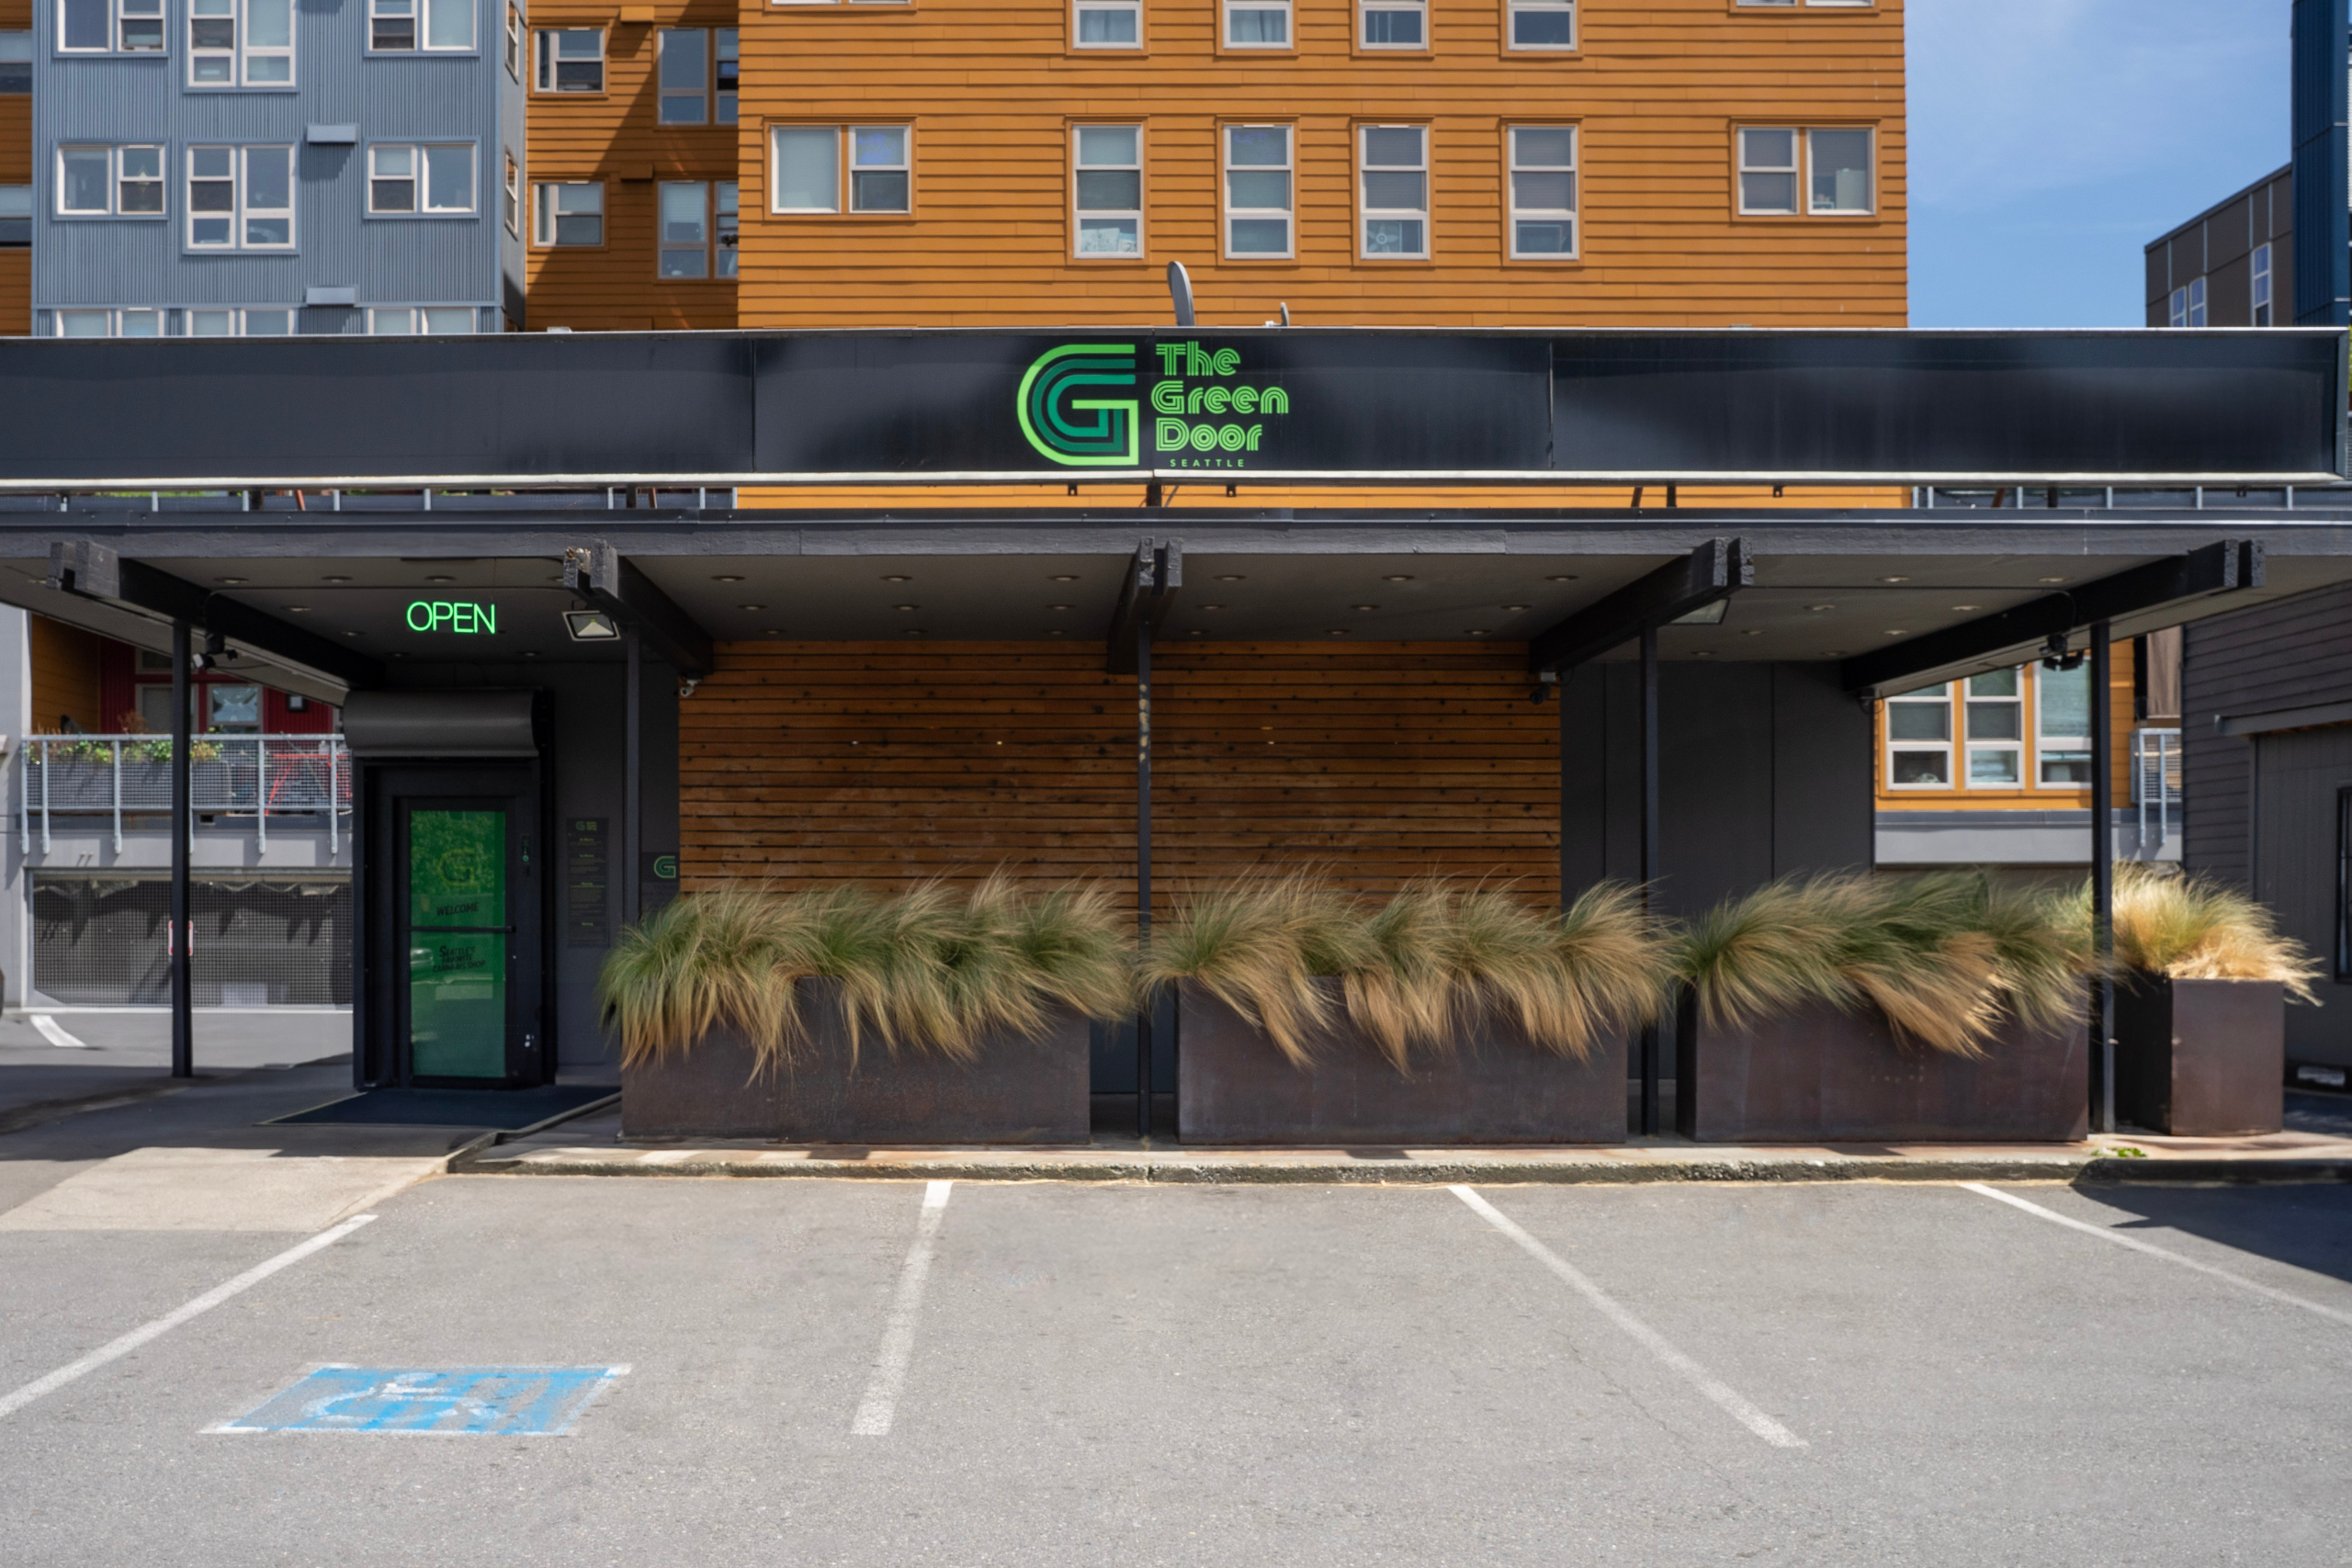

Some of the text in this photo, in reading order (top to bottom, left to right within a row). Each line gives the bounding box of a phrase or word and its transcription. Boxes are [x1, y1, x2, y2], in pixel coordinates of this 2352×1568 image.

[1155, 341, 1240, 377] The
[1017, 344, 1139, 466] G
[1150, 380, 1289, 414] Green
[1156, 417, 1262, 452] Door
[1170, 458, 1245, 468] SEATTLE
[406, 600, 496, 635] OPEN
[653, 855, 676, 879] G
[436, 902, 479, 916] WELCOME
